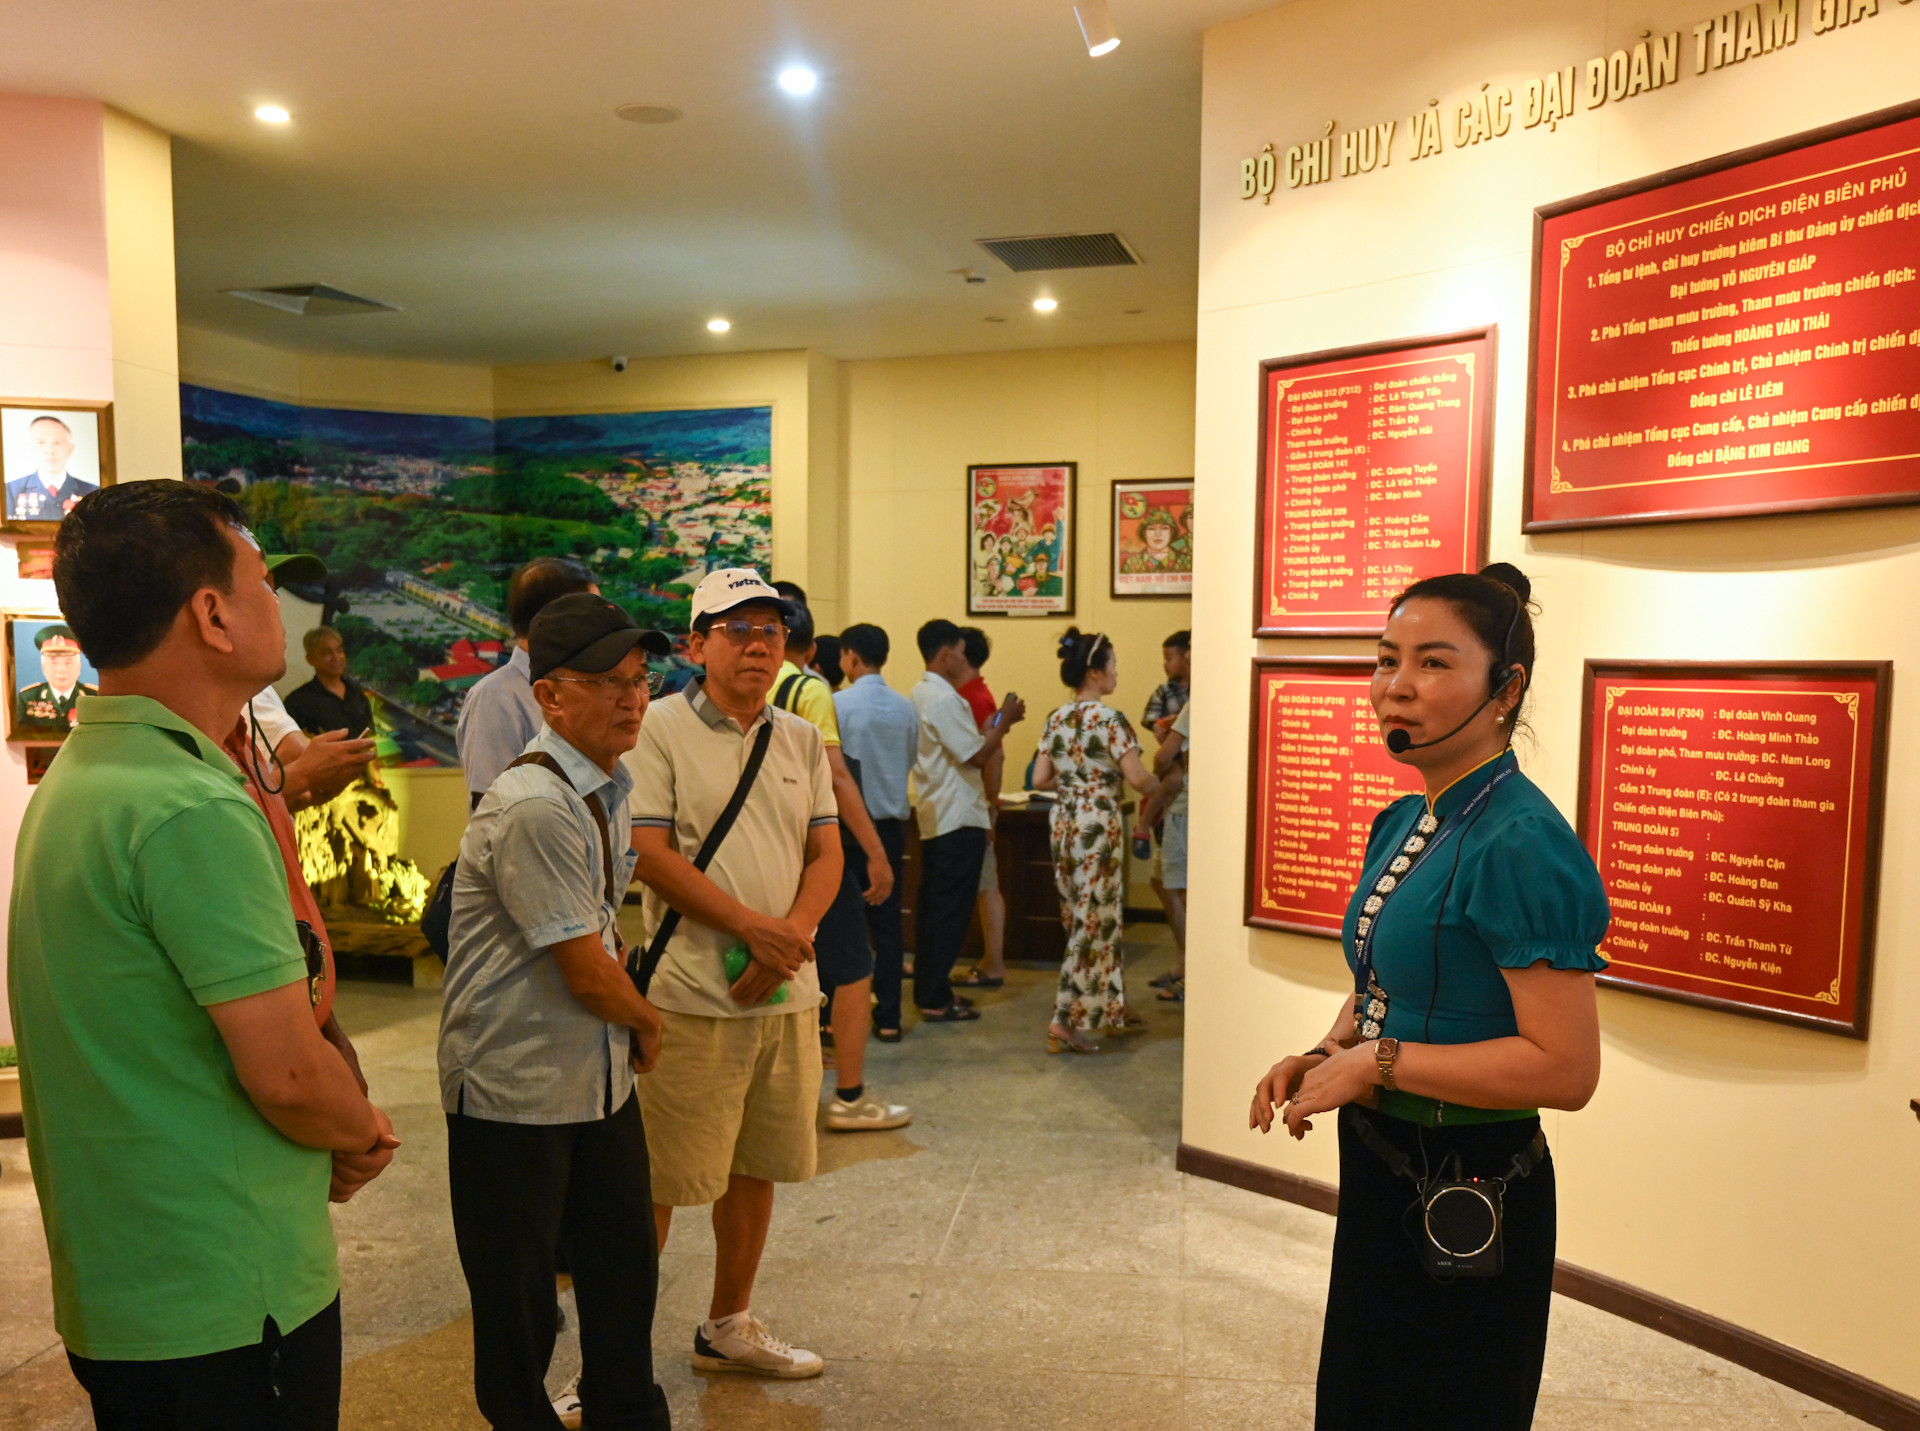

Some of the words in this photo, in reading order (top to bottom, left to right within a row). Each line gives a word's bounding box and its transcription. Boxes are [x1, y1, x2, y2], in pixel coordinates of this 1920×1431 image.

[1240, 143, 1276, 205] BỘ
[1285, 120, 1335, 188] CHỈ
[1340, 121, 1397, 177] HUY
[1452, 82, 1512, 148] CÁC
[1523, 65, 1576, 132] ĐẠI
[1693, 0, 1799, 76] THAM
[1606, 239, 1625, 257] BỘ
[1629, 230, 1652, 252] CHỈ
[1656, 227, 1684, 245] HUY
[1689, 212, 1734, 237] CHIẾN
[1739, 204, 1776, 225] DỊCH
[1781, 193, 1819, 215] ĐIỆN
[1825, 182, 1864, 205] BIÊN
[1870, 167, 1906, 193] PHỦ
[1588, 276, 1596, 288] 1.
[1681, 253, 1700, 267] huy
[1739, 238, 1767, 254] kiêm
[1770, 232, 1782, 247] Bí
[1858, 205, 1893, 227] chiến
[1670, 282, 1687, 299] Đại
[1739, 261, 1785, 283] NGUYÊN
[1788, 254, 1816, 273] GIÁP
[1591, 329, 1600, 341] 2.
[1602, 324, 1620, 339] Phó
[1649, 316, 1674, 330] tham
[1742, 296, 1772, 312] Tham
[1845, 271, 1880, 292] chiến
[1883, 267, 1915, 287] dịch:
[1734, 324, 1773, 343] HOÀNG
[1776, 318, 1800, 336] VĂN
[1803, 312, 1829, 331] THÁI
[1568, 386, 1577, 399] 3.
[1618, 376, 1649, 391] nhiệm
[1678, 369, 1697, 383] cục
[1700, 361, 1730, 378] Chính
[1775, 349, 1811, 366] nhiệm
[1815, 342, 1849, 360] Chính
[1870, 330, 1905, 351] chiến
[1324, 388, 1337, 397] 312
[1338, 385, 1361, 396] (F312)
[1739, 384, 1753, 401] LÊ
[1562, 440, 1571, 452] 4.
[1612, 432, 1642, 447] nhiệm
[1671, 426, 1690, 442] cục
[1693, 423, 1719, 436] Cung
[1772, 410, 1808, 427] nhiệm
[1811, 407, 1841, 421] Cung
[1871, 394, 1906, 414] chiến
[1715, 445, 1746, 464] ĐẶNG
[1748, 443, 1771, 458] KIM
[1773, 439, 1809, 456] GIANG
[1618, 706, 1632, 717] ĐẠI
[1634, 705, 1658, 716] ĐOÀN
[1661, 707, 1675, 717] 304
[1677, 708, 1704, 720] (F304)
[1719, 709, 1734, 720] Đại
[1761, 711, 1782, 721] Vinh
[1785, 712, 1816, 725] Quang
[1622, 725, 1635, 736] Đại
[1718, 730, 1734, 740] ĐC.
[1737, 731, 1766, 744] Hoàng
[1769, 732, 1792, 742] Minh
[1679, 748, 1703, 758] Tham
[1762, 753, 1778, 763] ĐC.
[1781, 754, 1802, 764] Nam
[1806, 756, 1830, 769] Long
[1640, 785, 1645, 794] 3
[1647, 785, 1671, 799] Trung
[1732, 792, 1738, 802] 2
[1740, 793, 1764, 806] trung
[1793, 798, 1816, 808] tham
[1820, 800, 1834, 812] gia
[1613, 821, 1641, 833] TRUNG
